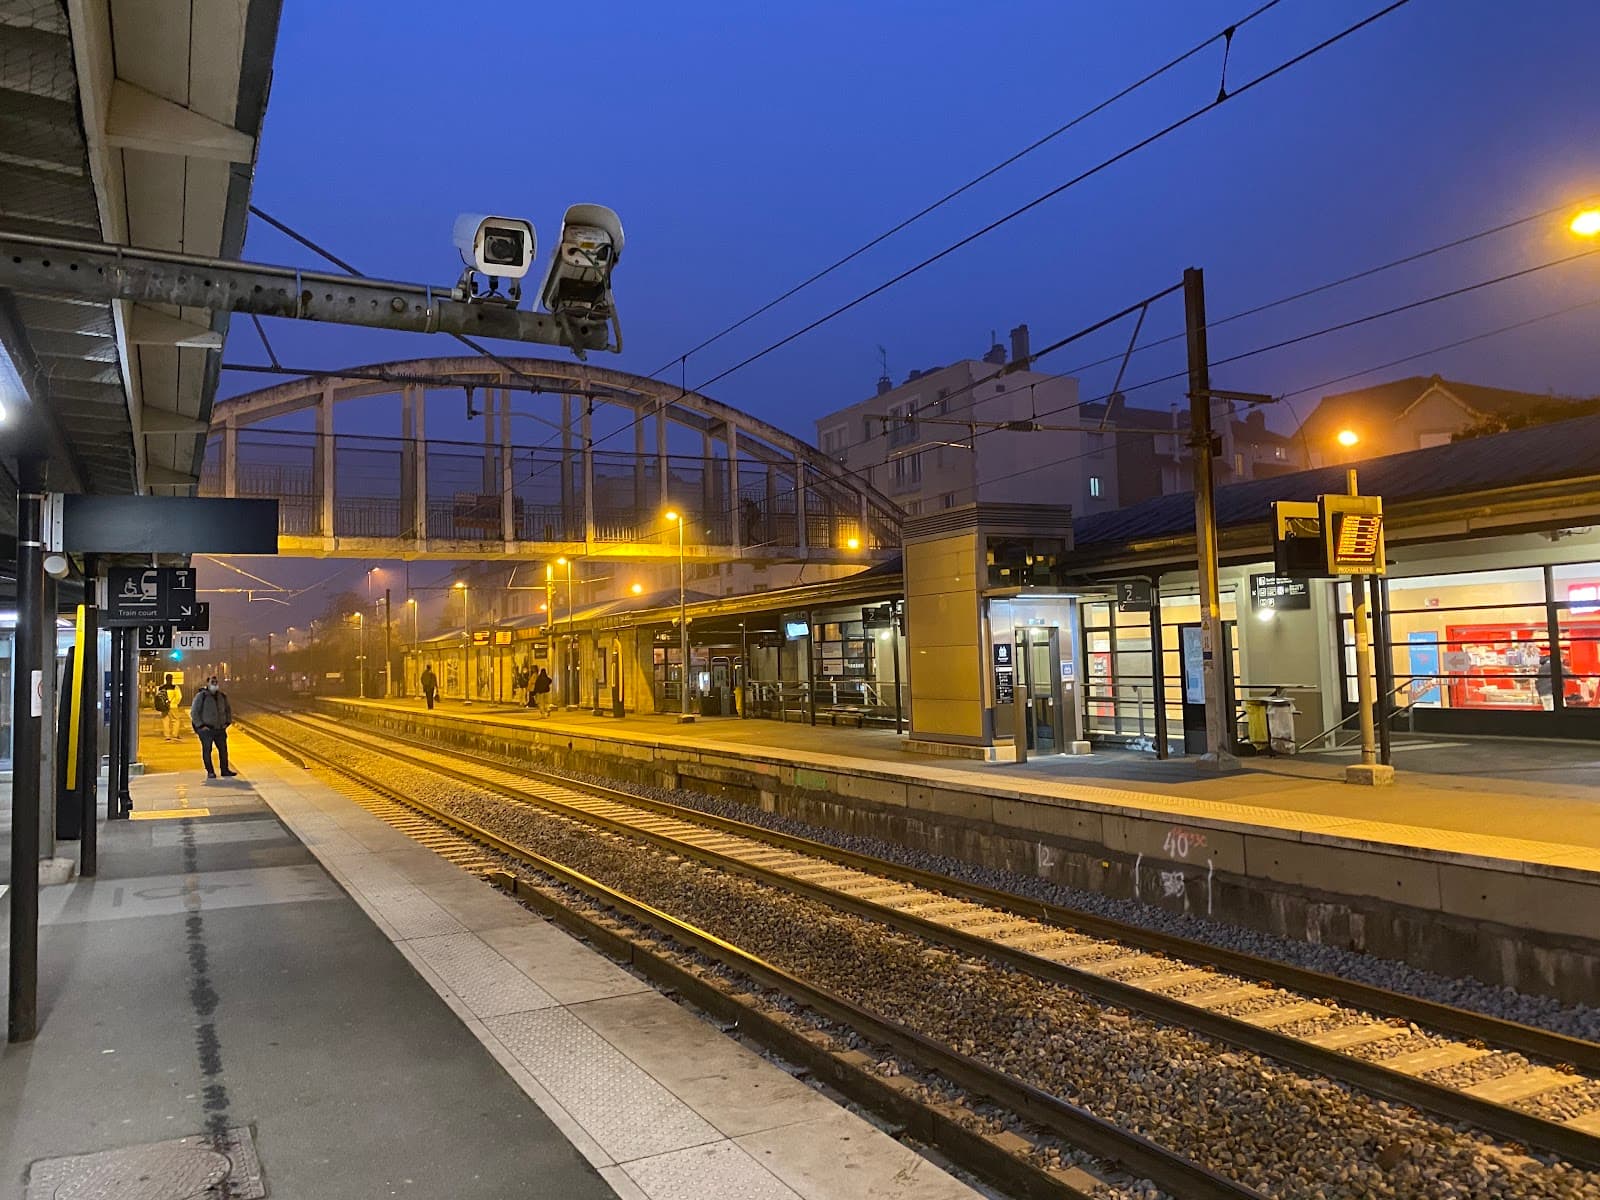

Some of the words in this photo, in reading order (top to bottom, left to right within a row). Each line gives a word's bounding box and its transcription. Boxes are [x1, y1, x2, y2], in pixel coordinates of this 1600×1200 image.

[178, 576, 186, 588] 1
[1126, 589, 1133, 601] 2
[869, 612, 875, 621] 2
[145, 634, 154, 646] 5
[157, 634, 166, 646] V
[180, 636, 204, 647] UFR
[1163, 831, 1189, 858] 40
